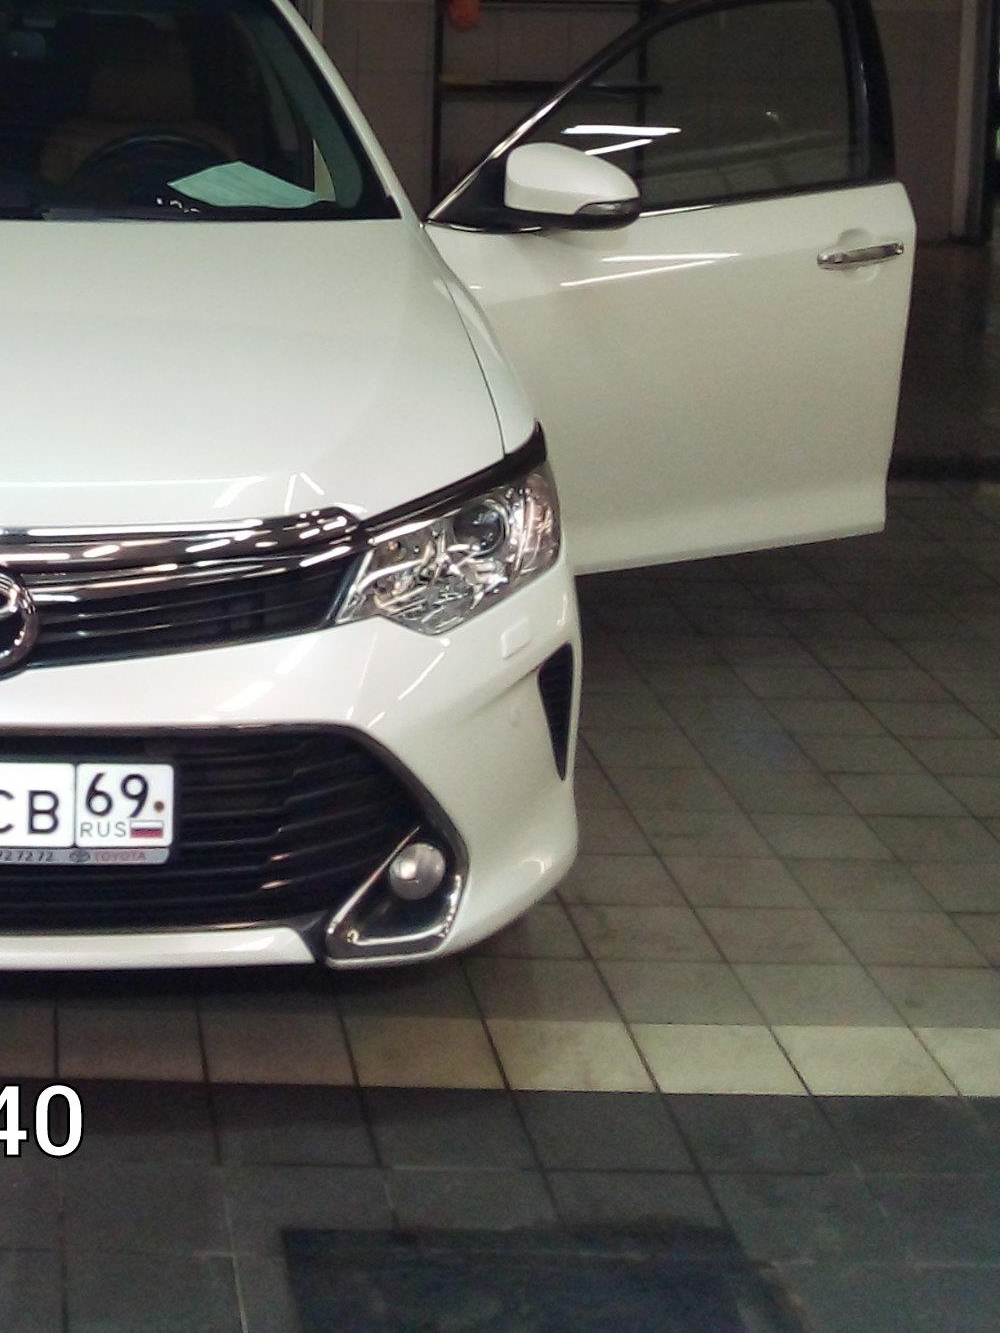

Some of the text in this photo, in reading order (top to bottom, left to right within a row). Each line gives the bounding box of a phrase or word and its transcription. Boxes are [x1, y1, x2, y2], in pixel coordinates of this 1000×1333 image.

[85, 773, 150, 818] 69
[80, 821, 127, 838] RUS
[94, 850, 147, 862] TOYOTA
